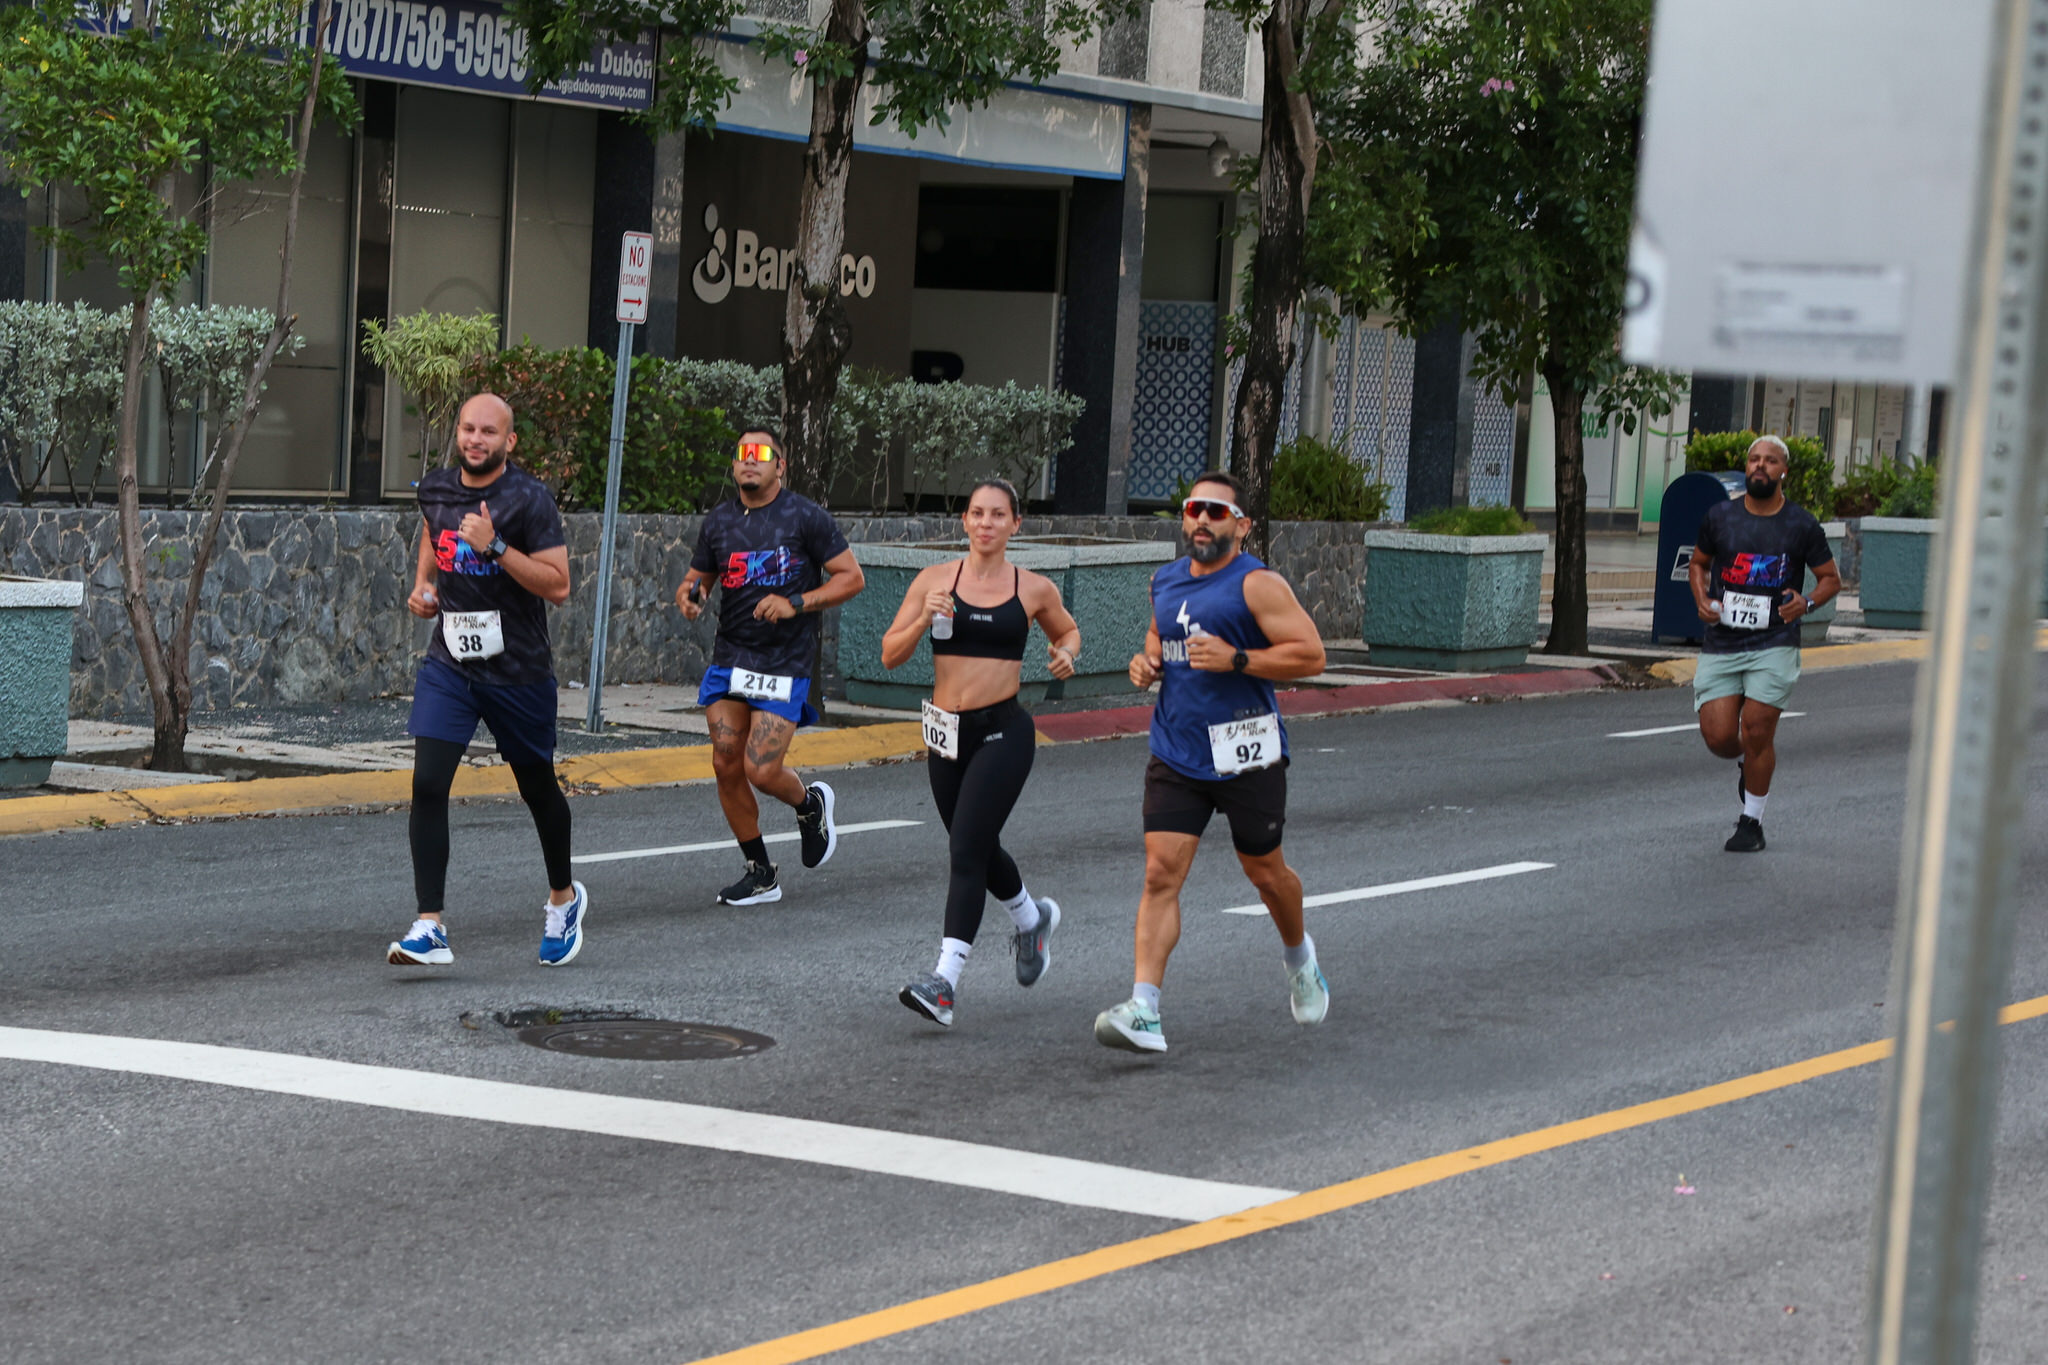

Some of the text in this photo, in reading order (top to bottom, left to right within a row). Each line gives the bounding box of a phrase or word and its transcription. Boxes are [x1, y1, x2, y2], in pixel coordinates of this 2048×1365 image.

[601, 48, 653, 79] Dubón
[629, 245, 645, 268] NO
[734, 229, 876, 299] Banco
[622, 273, 648, 288] ESTACIONE
[1146, 335, 1191, 353] HUB
[1485, 462, 1501, 477] HUB
[728, 549, 776, 578] 5K
[1731, 552, 1779, 577] 5K
[1731, 609, 1758, 626] 175
[458, 634, 483, 653] 38
[744, 673, 777, 693] 214
[924, 723, 947, 750] 102
[1235, 742, 1263, 764] 92
